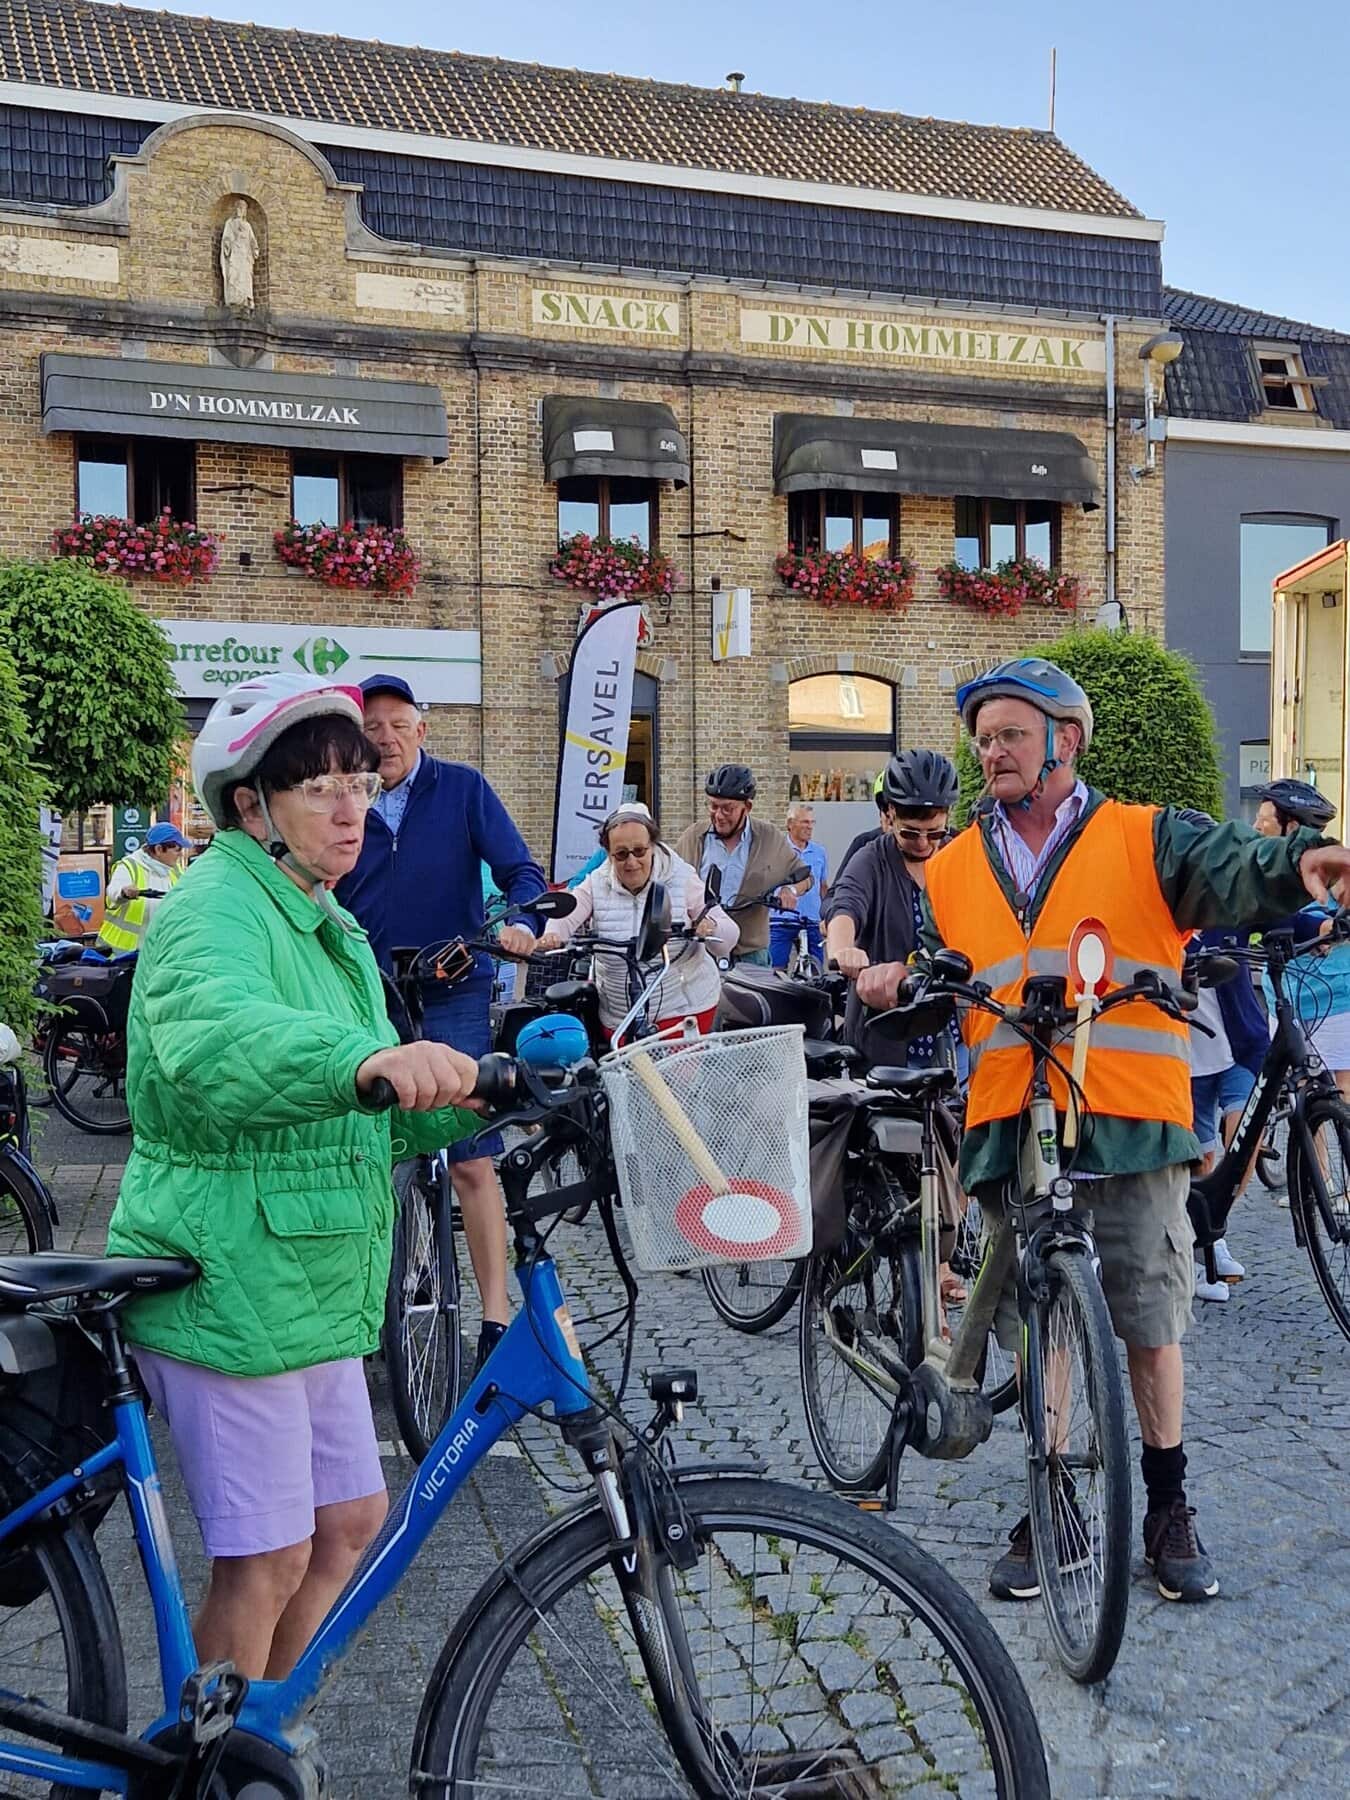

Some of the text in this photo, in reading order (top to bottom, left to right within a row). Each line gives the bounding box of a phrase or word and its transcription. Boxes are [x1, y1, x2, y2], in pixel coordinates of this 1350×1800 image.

[540, 292, 673, 332] SNACK
[767, 314, 1086, 368] D'N HOMMELZAK
[150, 391, 360, 426] D'N HOMMELZAK
[167, 637, 283, 663] arrefour
[203, 669, 280, 686] expre
[575, 660, 620, 830] VERSAVEL
[1249, 760, 1270, 773] PIZ
[1229, 1071, 1268, 1153] TREK
[419, 1417, 480, 1502] VICTORIA
